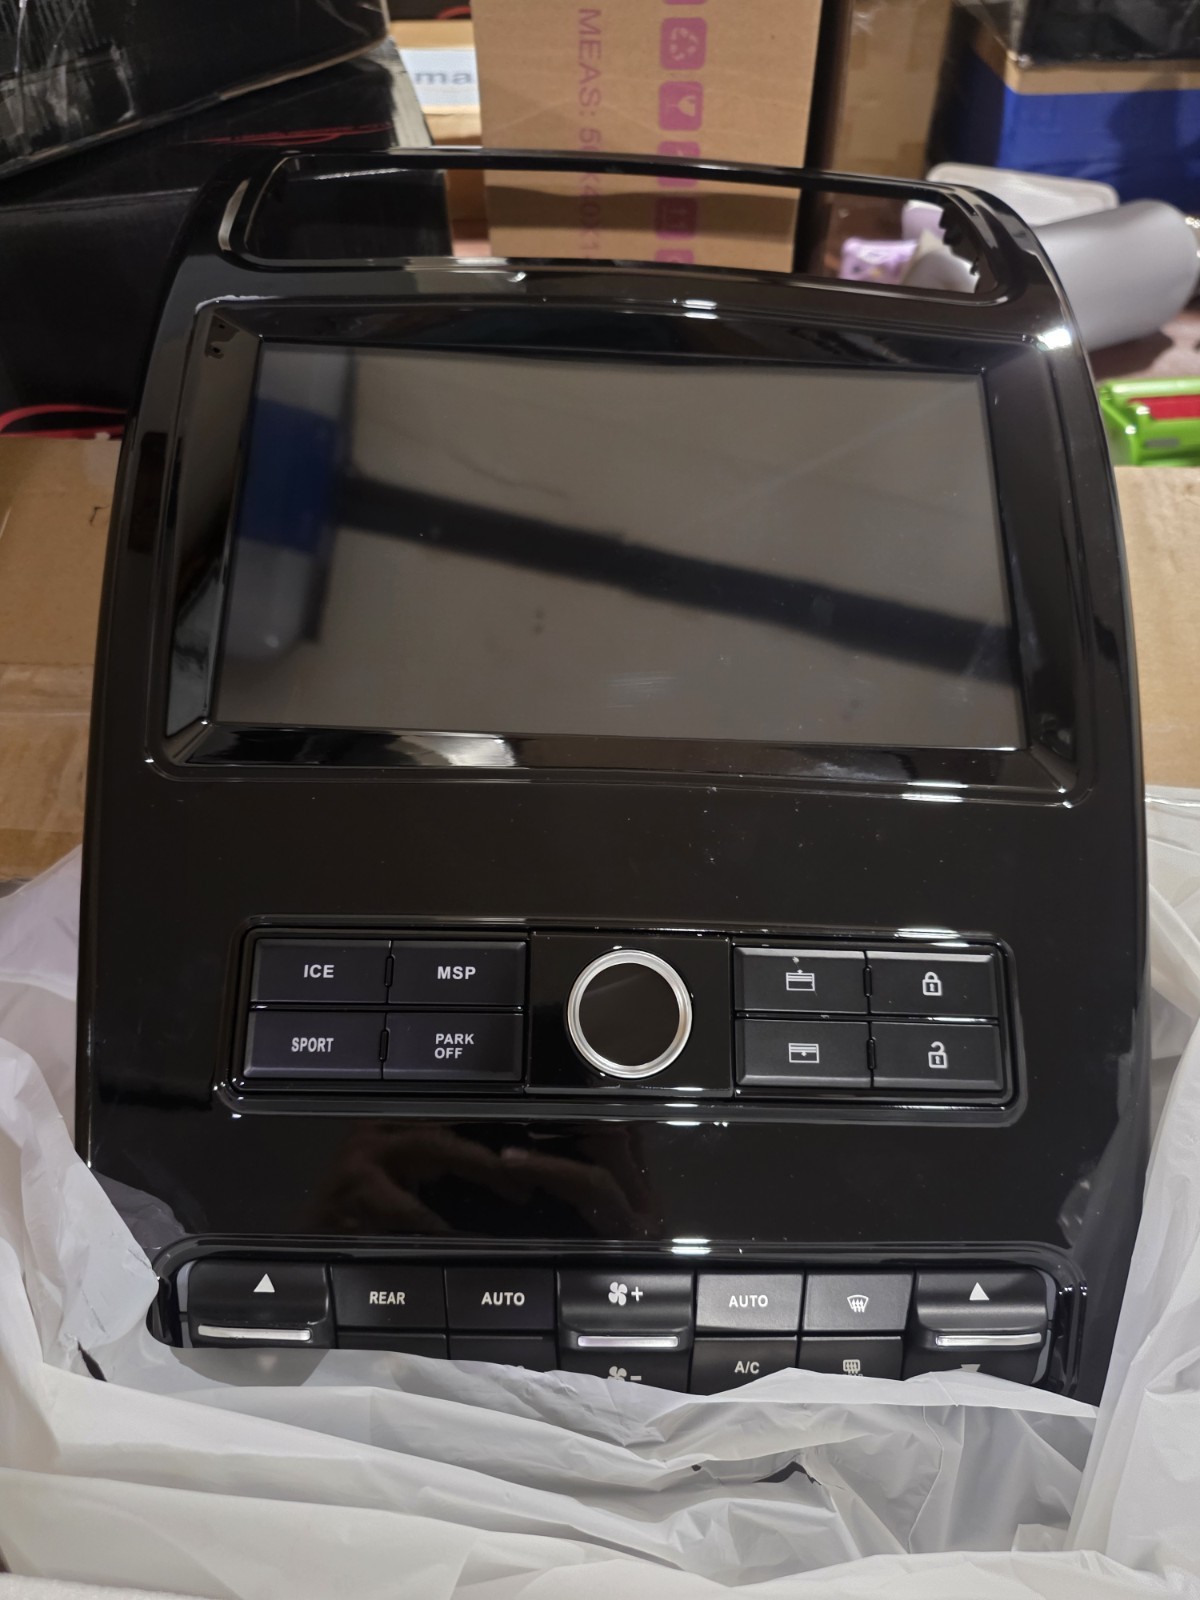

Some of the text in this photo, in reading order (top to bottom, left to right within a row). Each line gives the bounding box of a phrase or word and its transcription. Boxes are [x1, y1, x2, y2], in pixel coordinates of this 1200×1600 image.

[577, 8, 601, 118] MEAS:
[303, 964, 335, 979] ICE
[437, 965, 476, 980] MSP
[291, 1037, 334, 1053] SPORT
[435, 1033, 474, 1045] PARK
[434, 1047, 463, 1059] OFF
[369, 1291, 406, 1305] REAR
[481, 1291, 525, 1306] AUTO
[728, 1294, 769, 1308] AUTO
[734, 1360, 760, 1375] A/C
